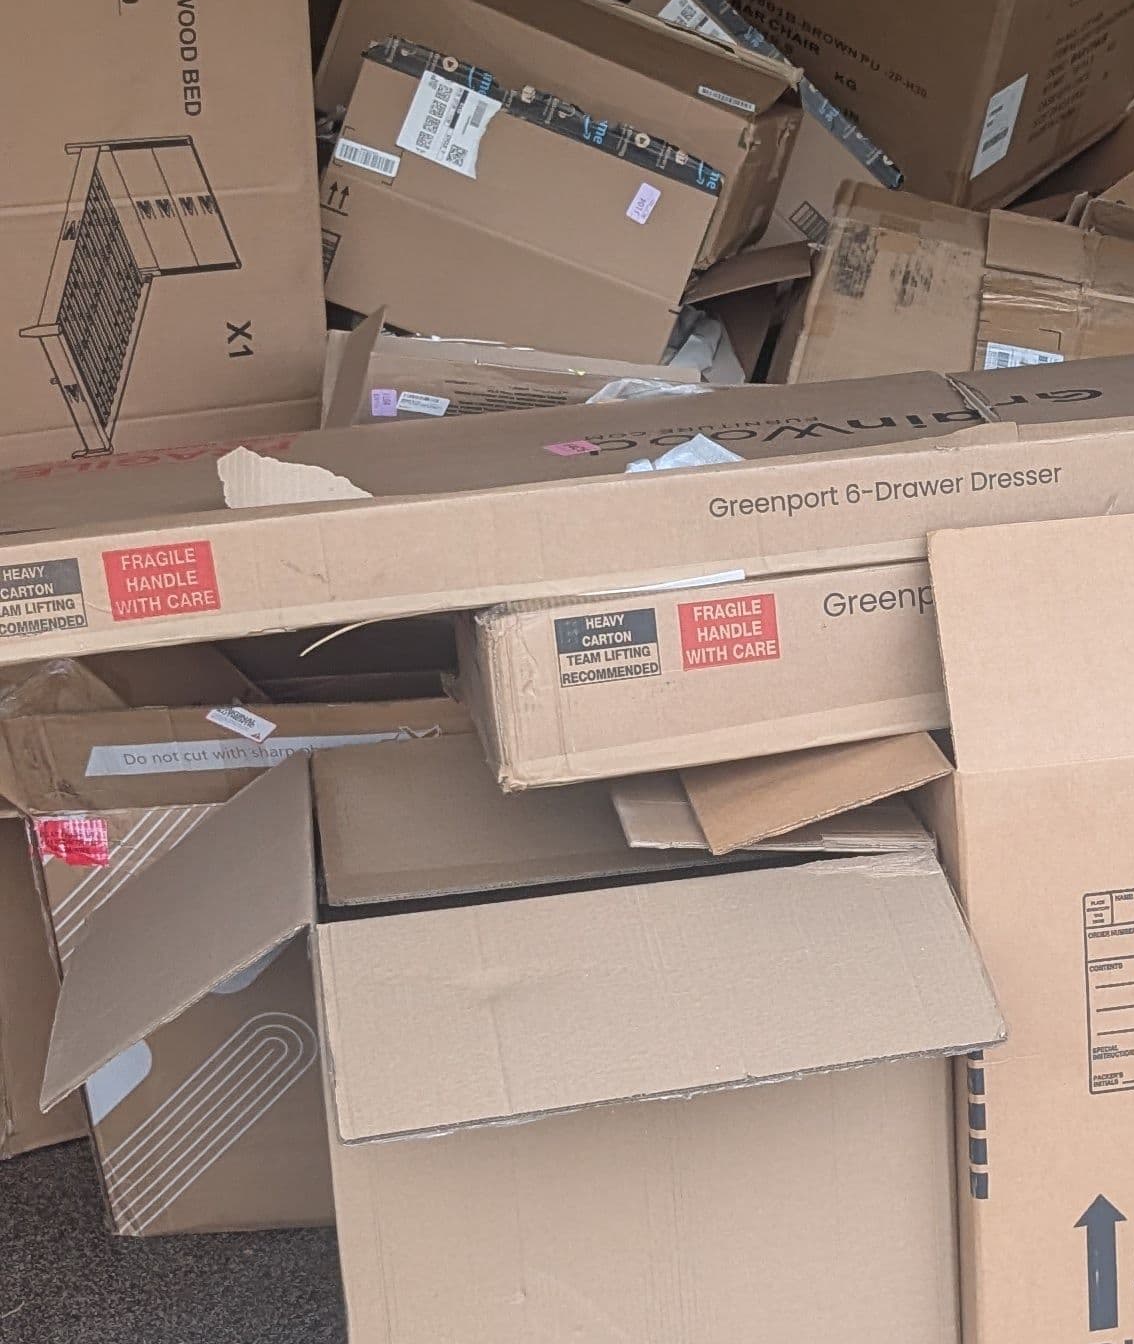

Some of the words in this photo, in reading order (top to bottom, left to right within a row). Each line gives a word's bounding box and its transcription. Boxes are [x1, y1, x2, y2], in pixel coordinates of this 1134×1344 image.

[769, 18, 821, 56] CHAIR
[182, 70, 201, 117] BED
[225, 320, 254, 360] X1
[709, 485, 840, 518] Greenport
[845, 475, 965, 504] 6-Drawer
[970, 465, 1063, 492] Dresser
[121, 547, 197, 571] FRAGILE
[2, 565, 45, 582] HEAVY
[126, 570, 199, 593] HANDLE
[0, 582, 54, 599] CARTON
[24, 598, 76, 616] LIFTING
[115, 596, 162, 616] WITH
[167, 590, 217, 610] CARE
[693, 599, 762, 622] FRAGILE
[586, 614, 625, 630] HEAVY
[697, 621, 763, 643] HANDLE
[582, 630, 632, 648] CARTON
[567, 651, 601, 666] TEAM
[605, 646, 651, 662] LIFTING
[686, 647, 728, 665] WITH
[732, 640, 777, 660] CARE
[562, 662, 659, 685] RECOMMENDED
[123, 752, 148, 766] Do
[152, 750, 179, 765] not
[184, 749, 208, 762] cut
[215, 746, 247, 760] with
[251, 745, 294, 760] sharp
[1114, 893, 1134, 902] NAME
[1088, 928, 1111, 939] ORDER
[1089, 962, 1123, 973] CONTENTS
